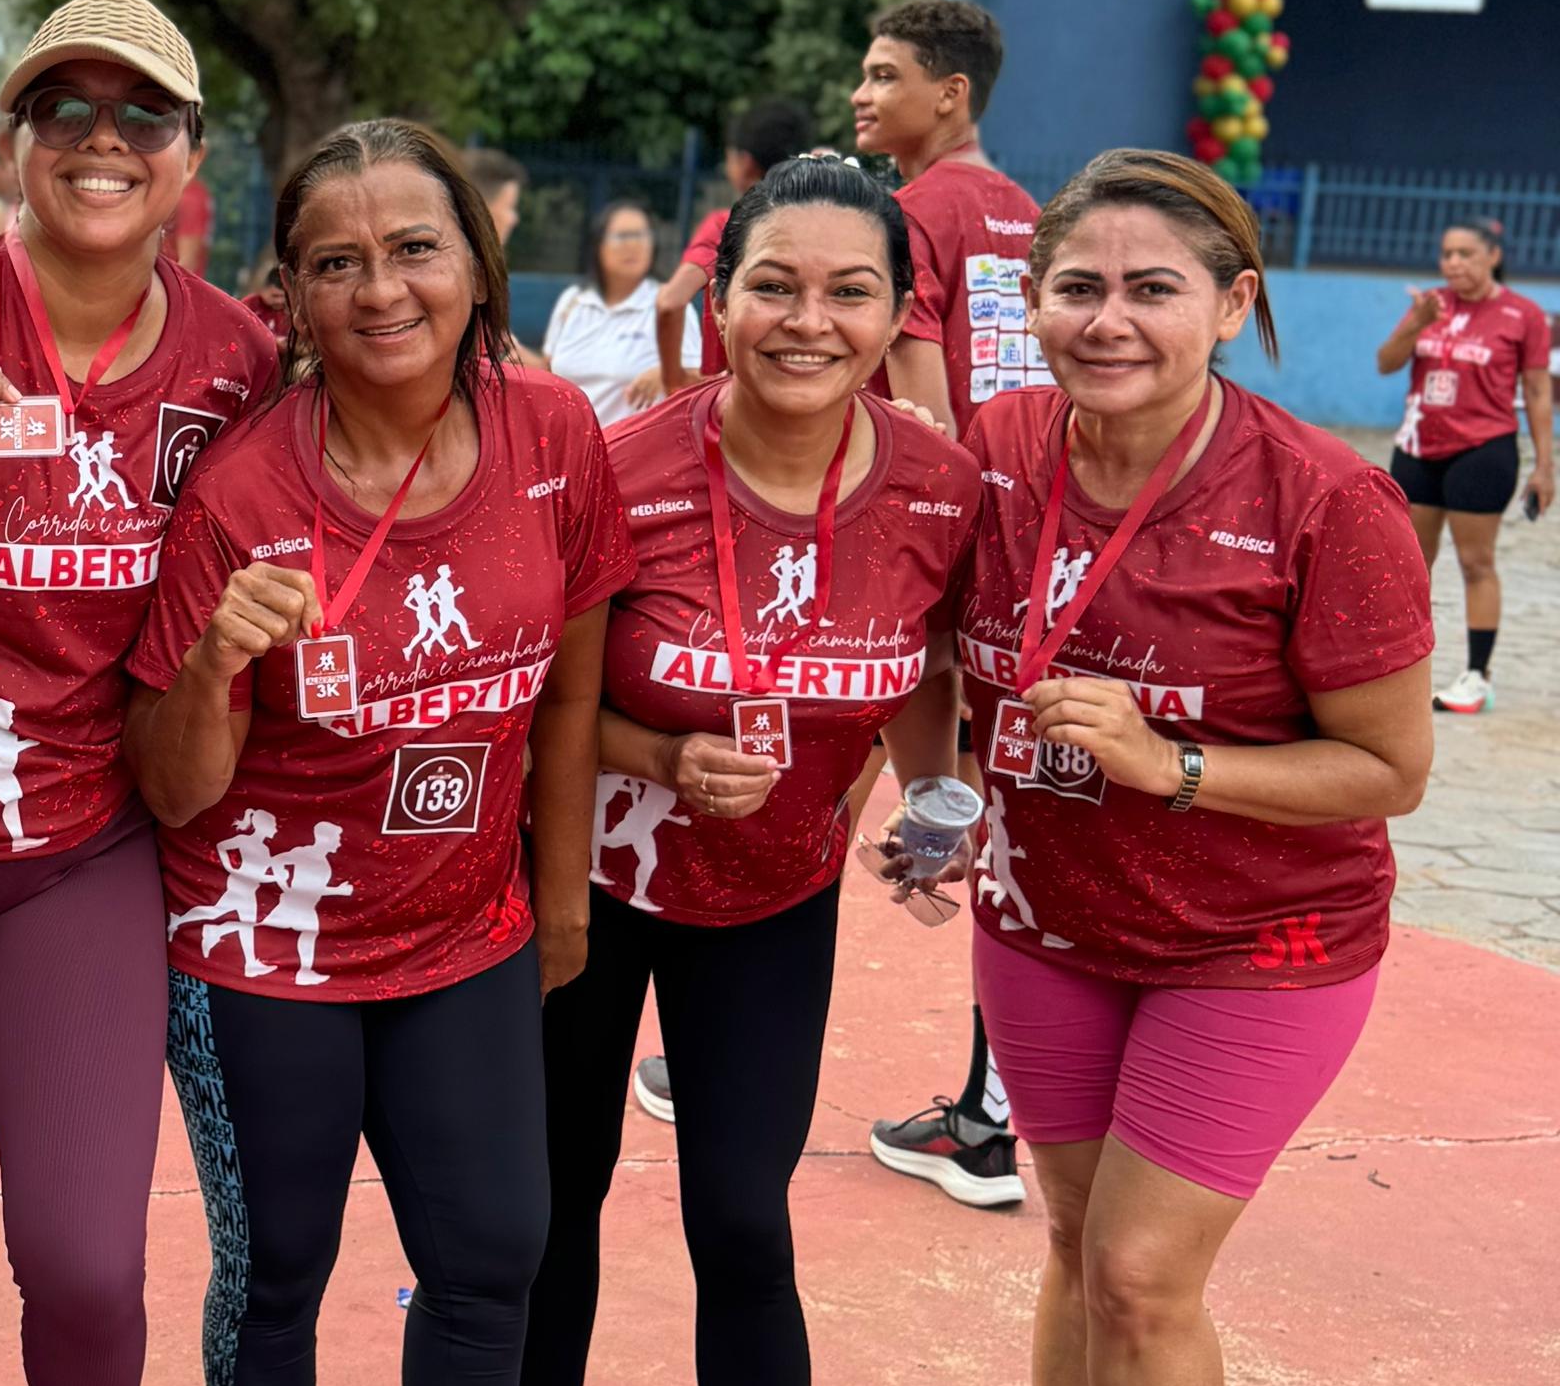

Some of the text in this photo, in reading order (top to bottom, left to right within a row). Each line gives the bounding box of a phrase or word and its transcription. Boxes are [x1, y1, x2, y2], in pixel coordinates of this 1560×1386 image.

[630, 499, 694, 517] #ED.FÍSICA
[4, 496, 95, 545] Corrida
[251, 537, 313, 559] #ED.FÍSICA
[1209, 530, 1275, 554] #ED.FÍSICA
[808, 617, 910, 660] caminhada
[359, 652, 435, 701] orrida
[316, 683, 340, 698] 3K
[752, 741, 775, 753] 3K
[1004, 744, 1024, 760] 3K
[414, 777, 464, 812] 133
